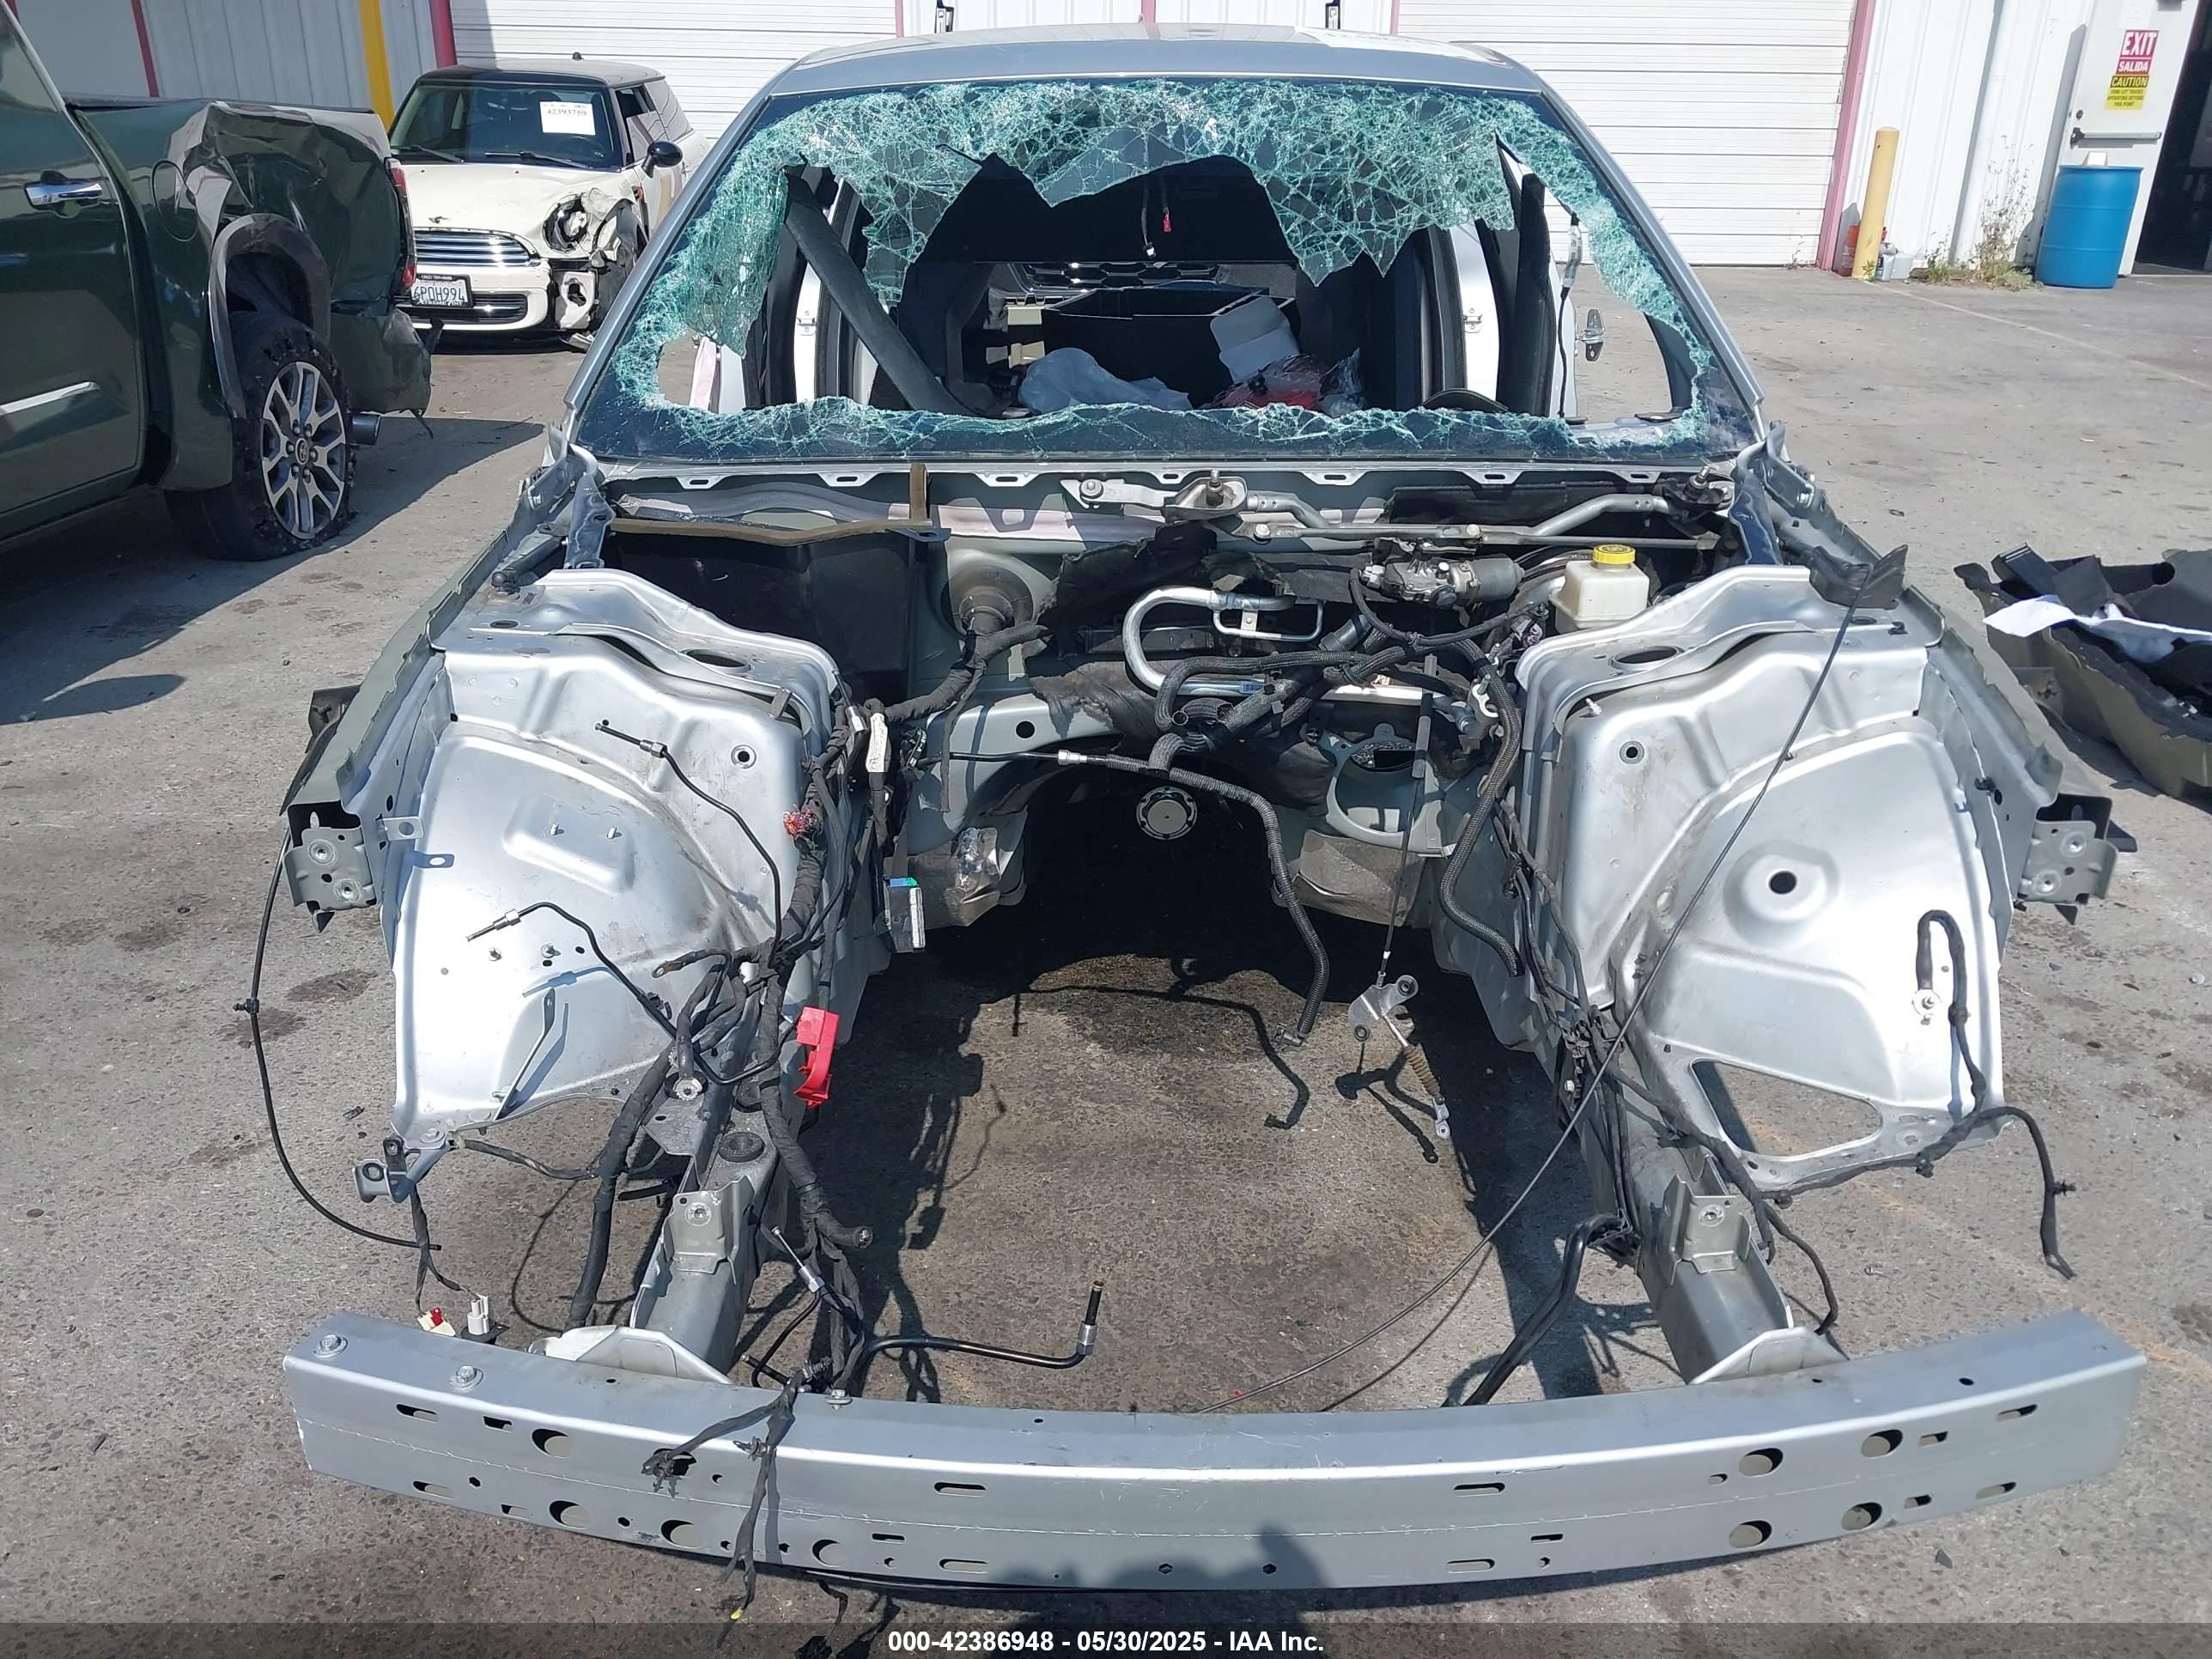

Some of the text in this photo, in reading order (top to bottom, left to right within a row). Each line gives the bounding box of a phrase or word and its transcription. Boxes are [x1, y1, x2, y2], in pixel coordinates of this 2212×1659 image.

[2122, 31, 2158, 56] EXIT
[2118, 60, 2148, 72] SALIDA
[2112, 76, 2148, 87] CAUTION
